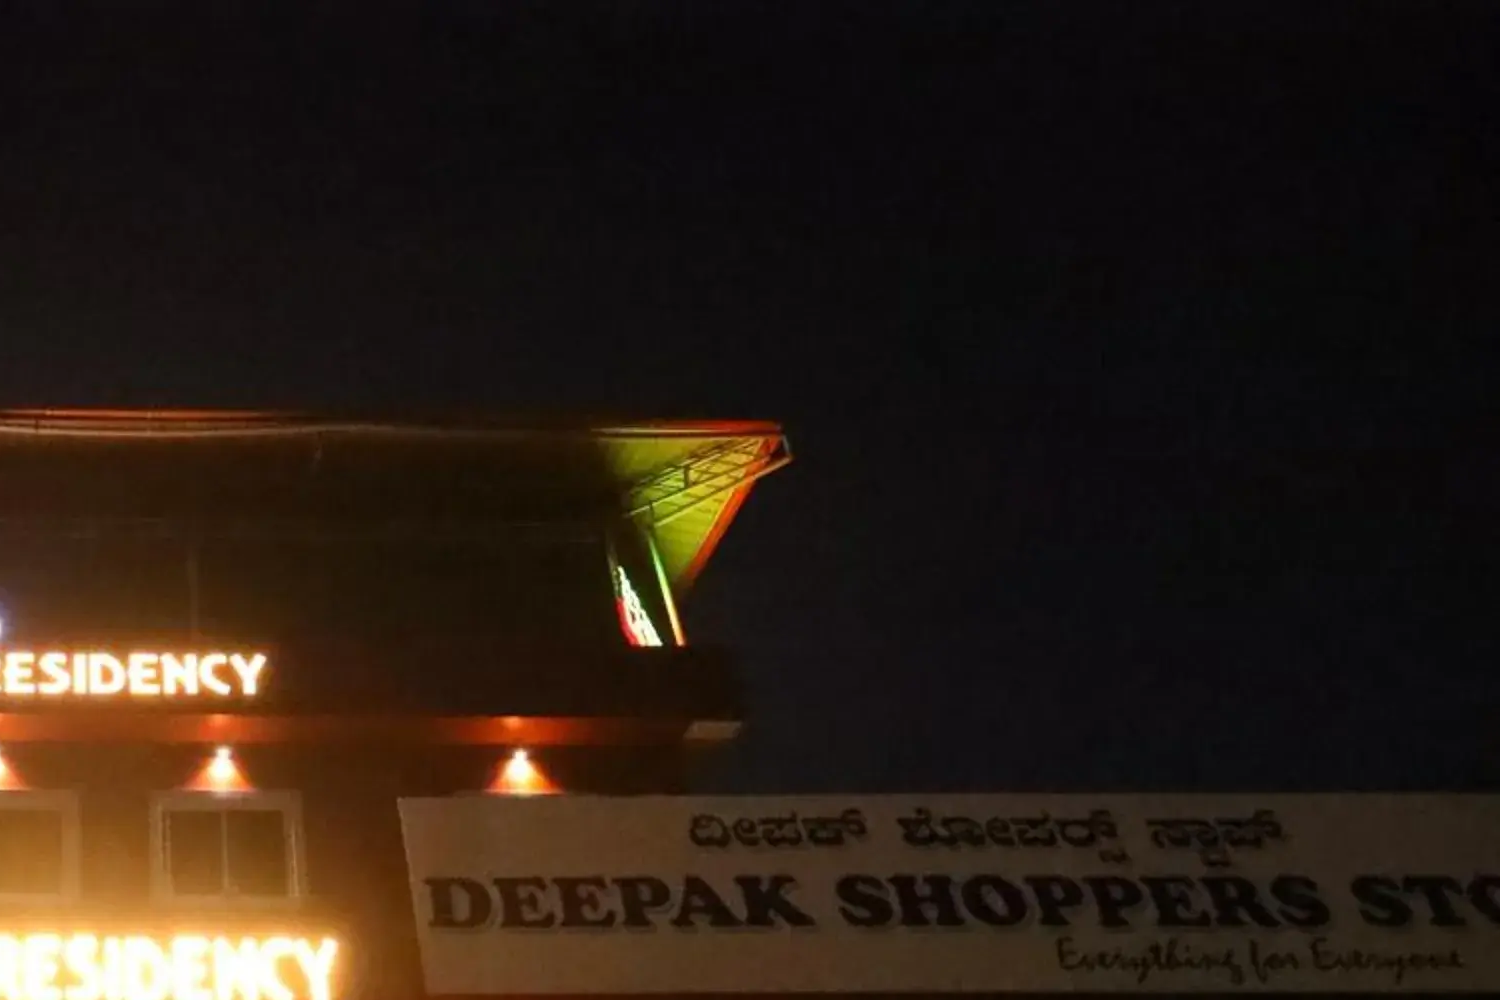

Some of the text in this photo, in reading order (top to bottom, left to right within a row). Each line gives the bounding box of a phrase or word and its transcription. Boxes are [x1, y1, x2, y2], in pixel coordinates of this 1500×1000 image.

[423, 874, 816, 930] DEEPAK
[836, 874, 1331, 928] SHOPPERS
[1056, 937, 1465, 985] Everything for Everyone
